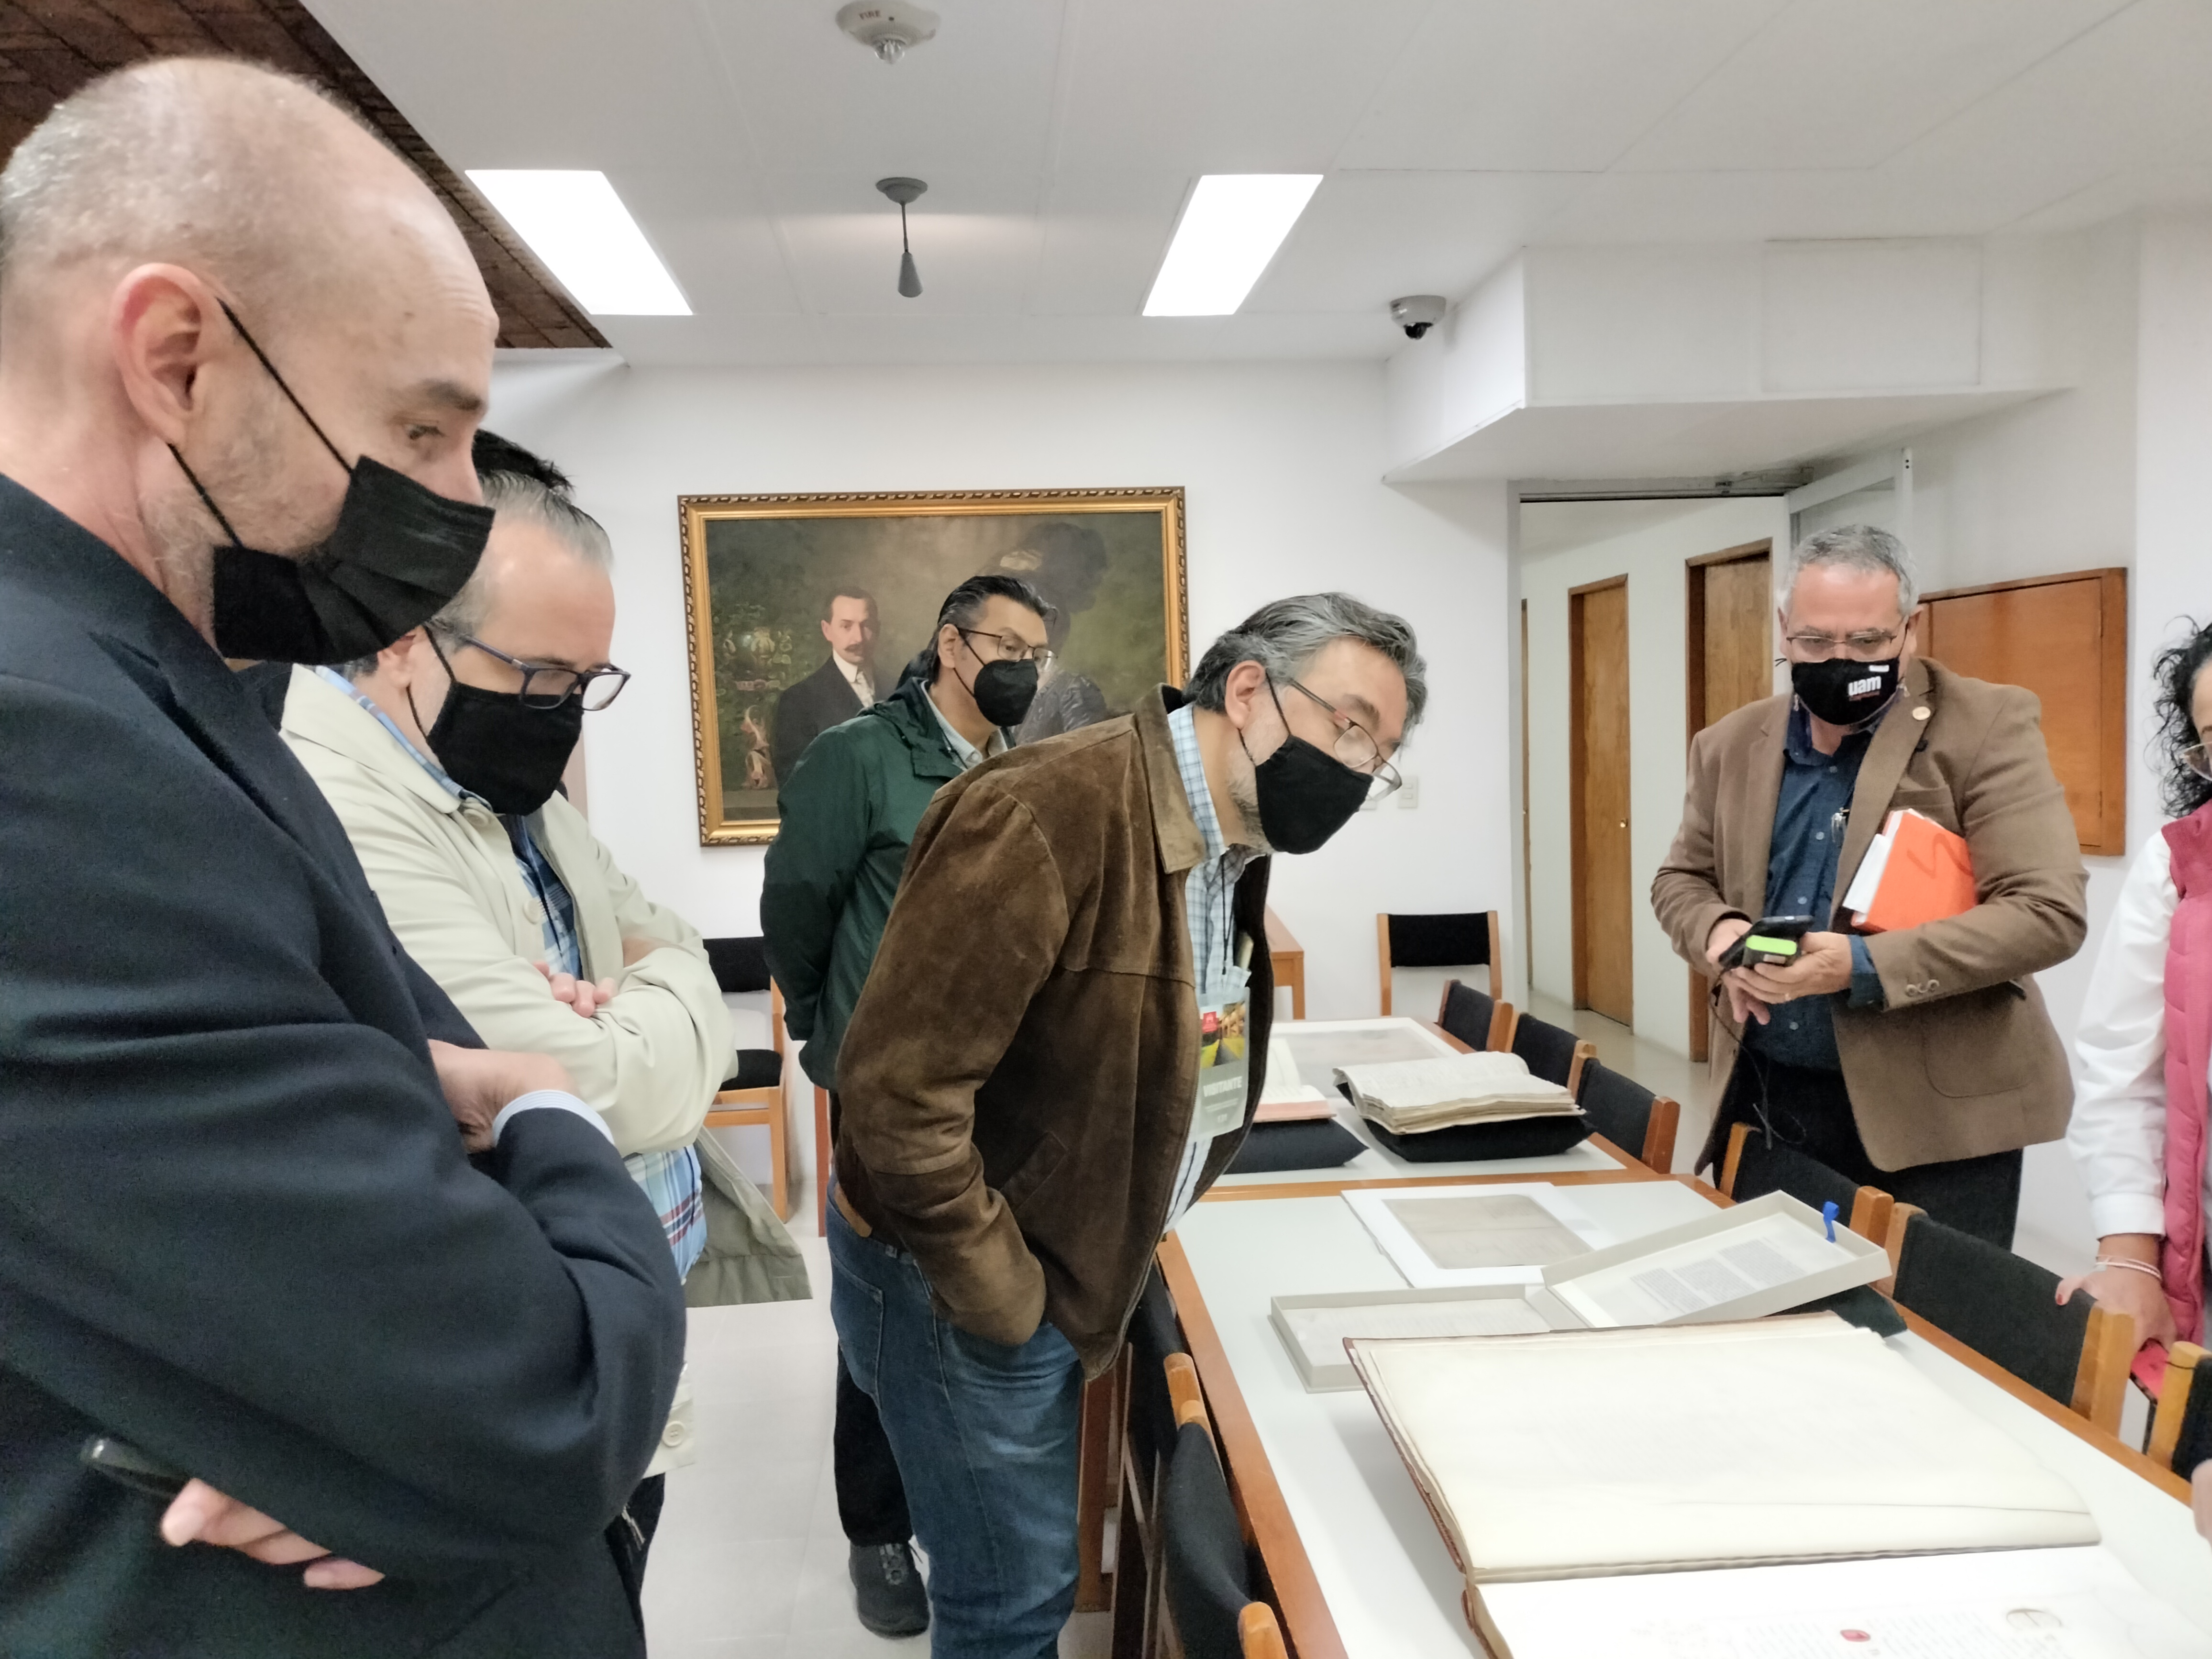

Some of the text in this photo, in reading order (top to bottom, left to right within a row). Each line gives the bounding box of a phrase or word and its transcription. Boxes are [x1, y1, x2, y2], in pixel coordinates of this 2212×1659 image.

[859, 10, 881, 20] FIRE
[1848, 676, 1881, 696] uam
[1203, 1076, 1242, 1097] VISITANTE
